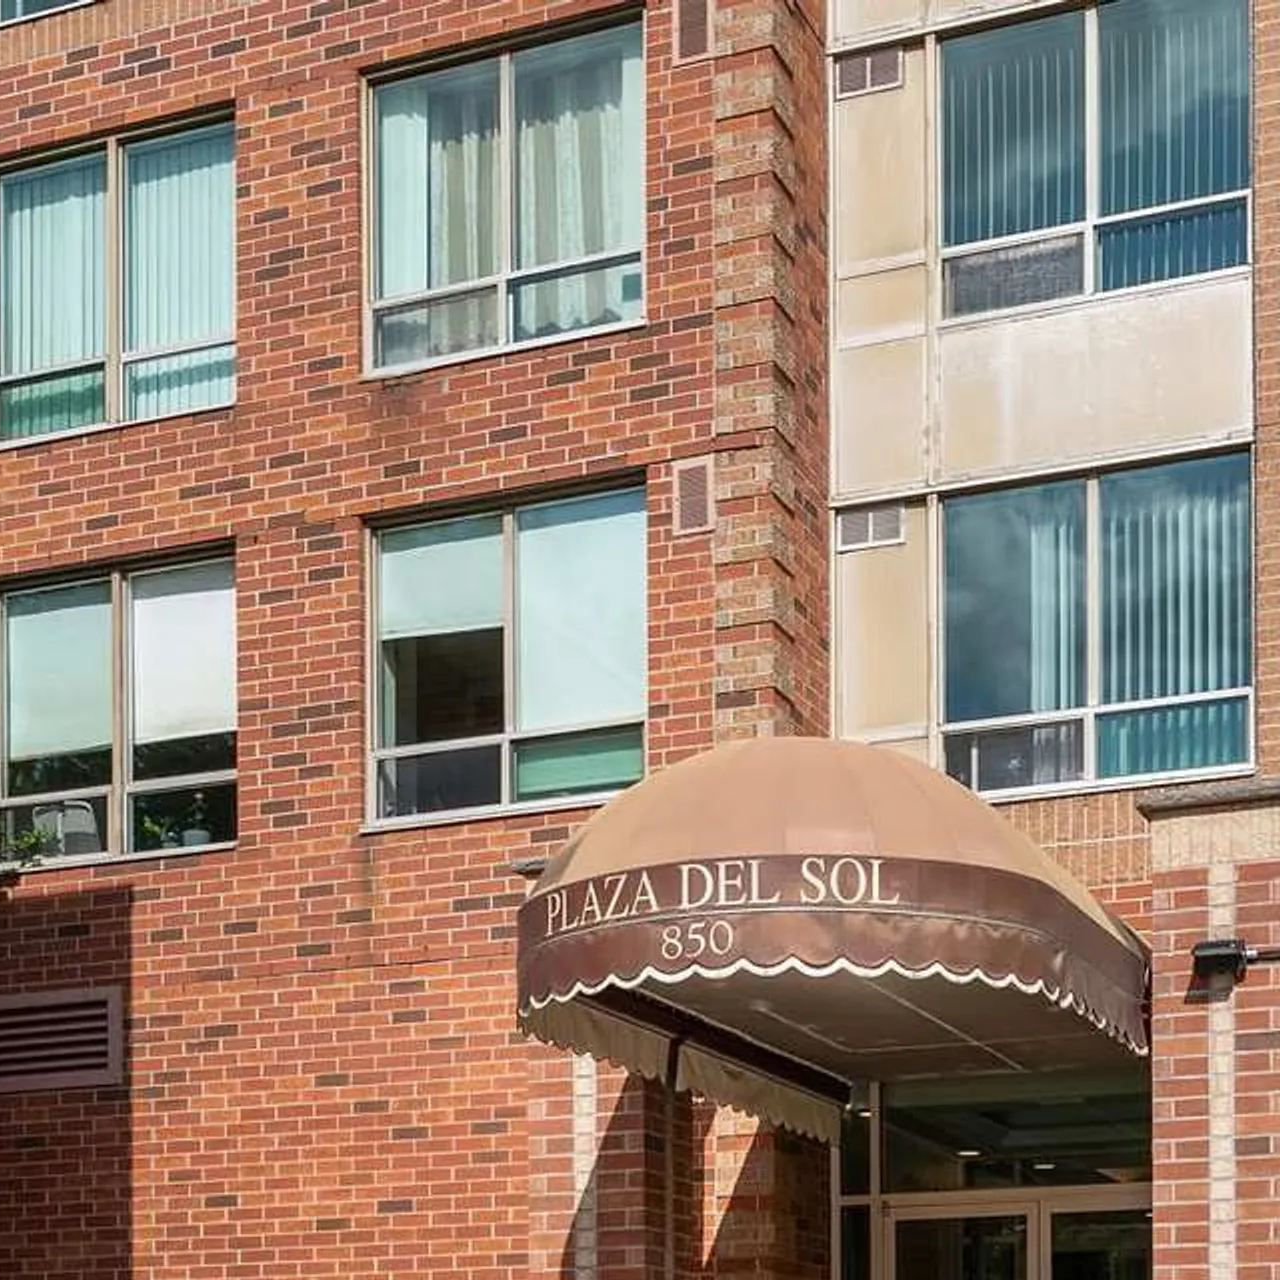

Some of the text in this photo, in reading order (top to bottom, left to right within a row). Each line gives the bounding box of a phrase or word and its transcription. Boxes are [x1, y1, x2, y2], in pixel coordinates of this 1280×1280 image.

[546, 857, 901, 938] PLAZA DEL SOL
[660, 919, 735, 961] 850
